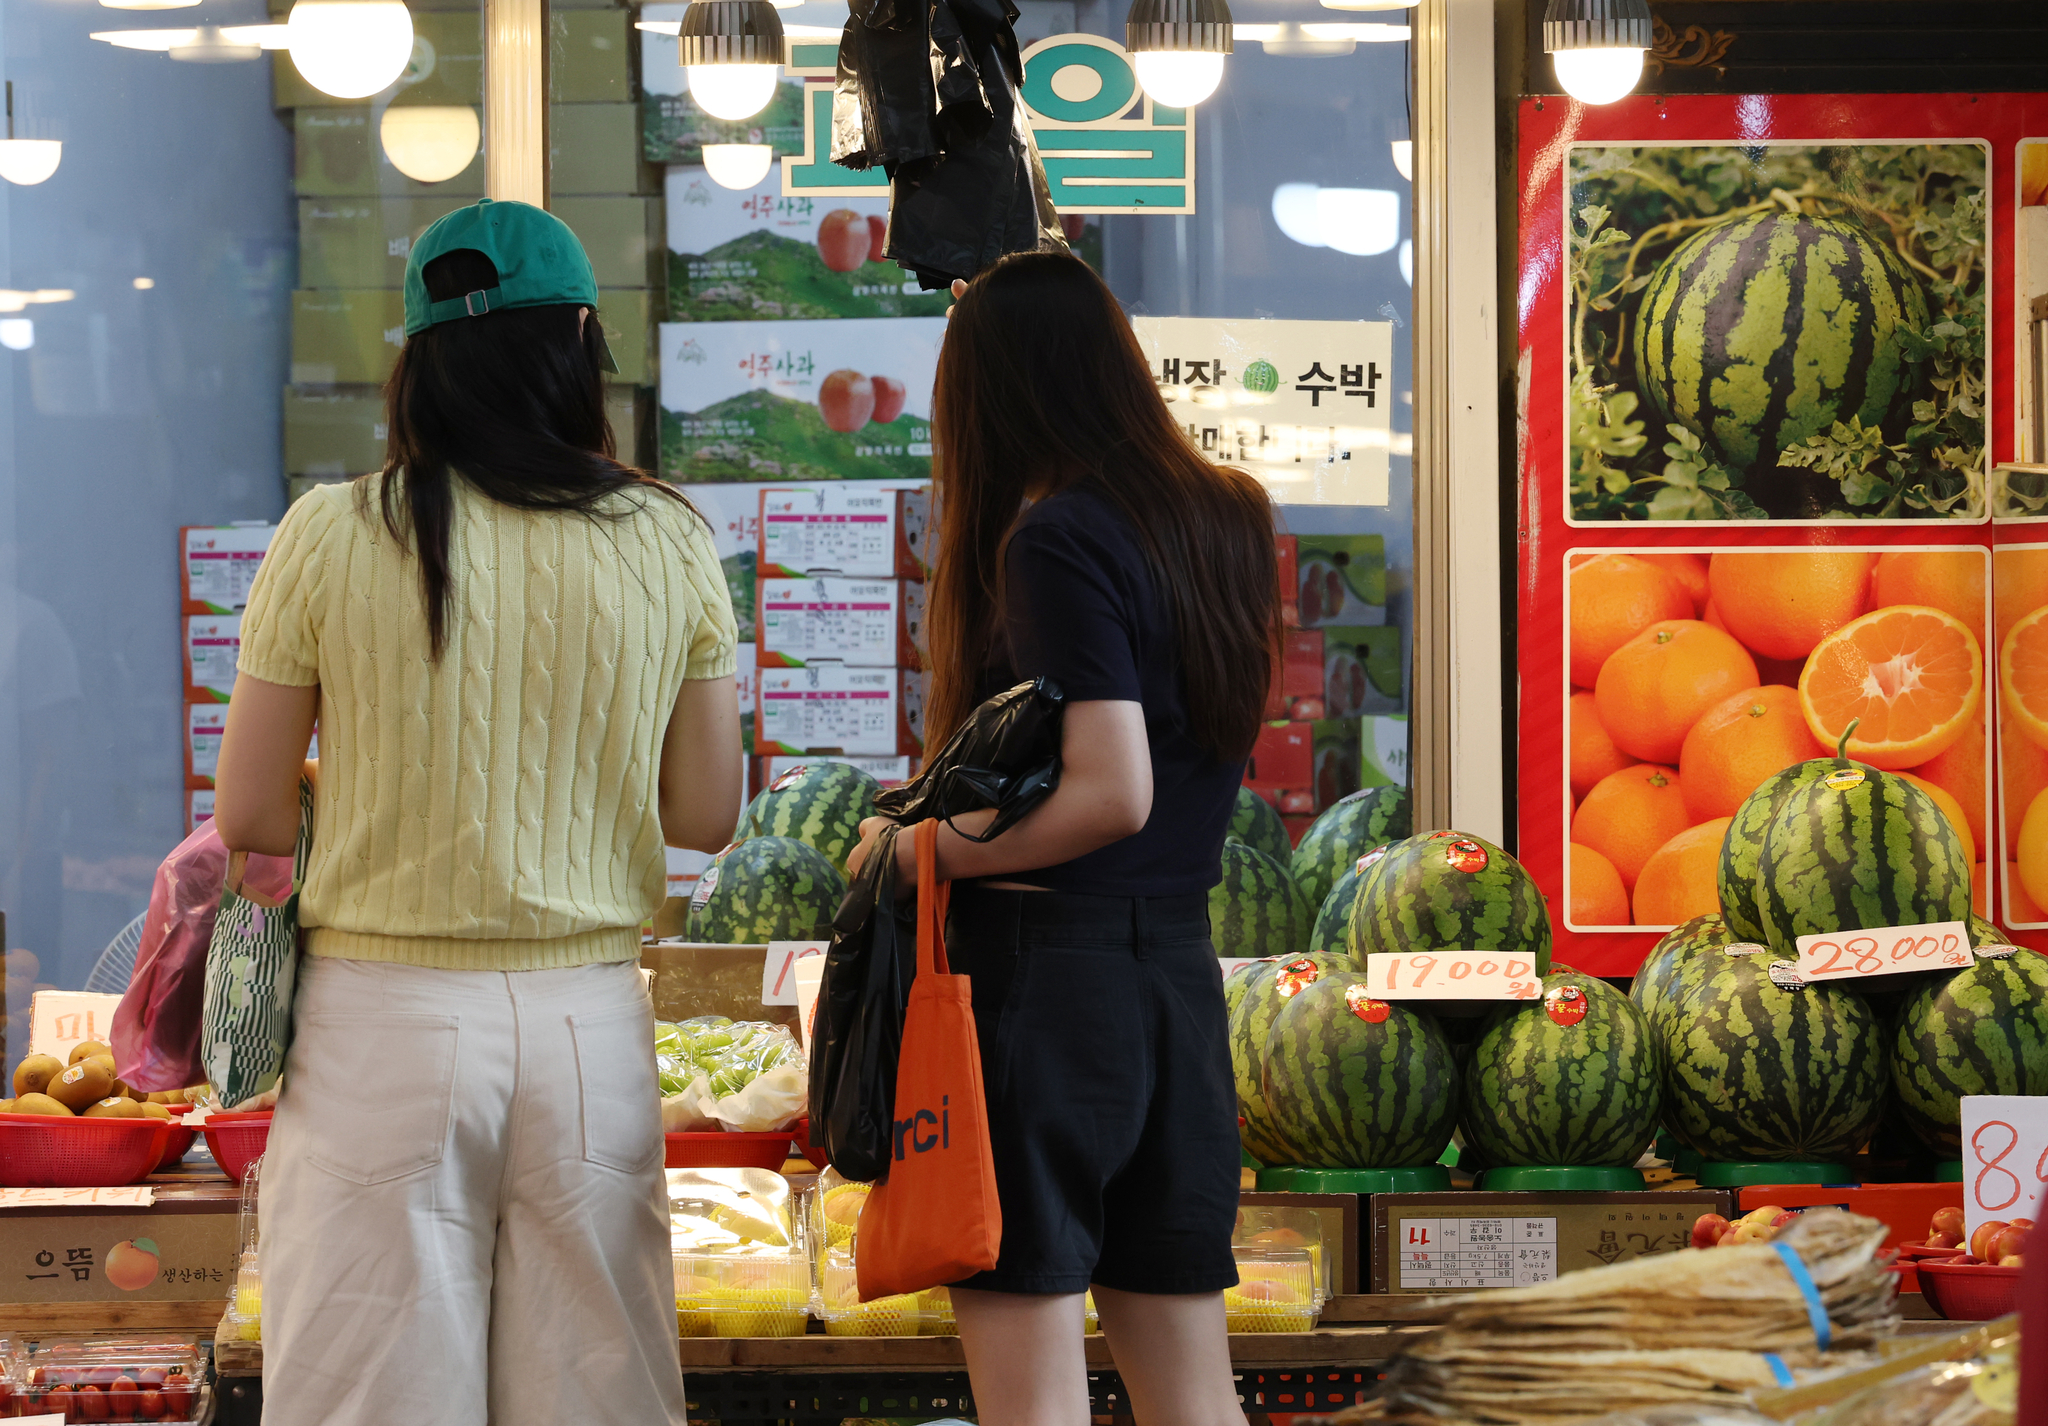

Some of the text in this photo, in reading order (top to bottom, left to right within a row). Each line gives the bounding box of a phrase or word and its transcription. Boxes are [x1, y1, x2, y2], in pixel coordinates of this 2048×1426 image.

[738, 350, 815, 379] 영주사과
[1295, 361, 1382, 408] 수박
[1409, 1227, 1430, 1245] 11
[26, 1247, 223, 1283] 으뜸 생산하는
[1410, 1261, 1432, 1269] 평택시
